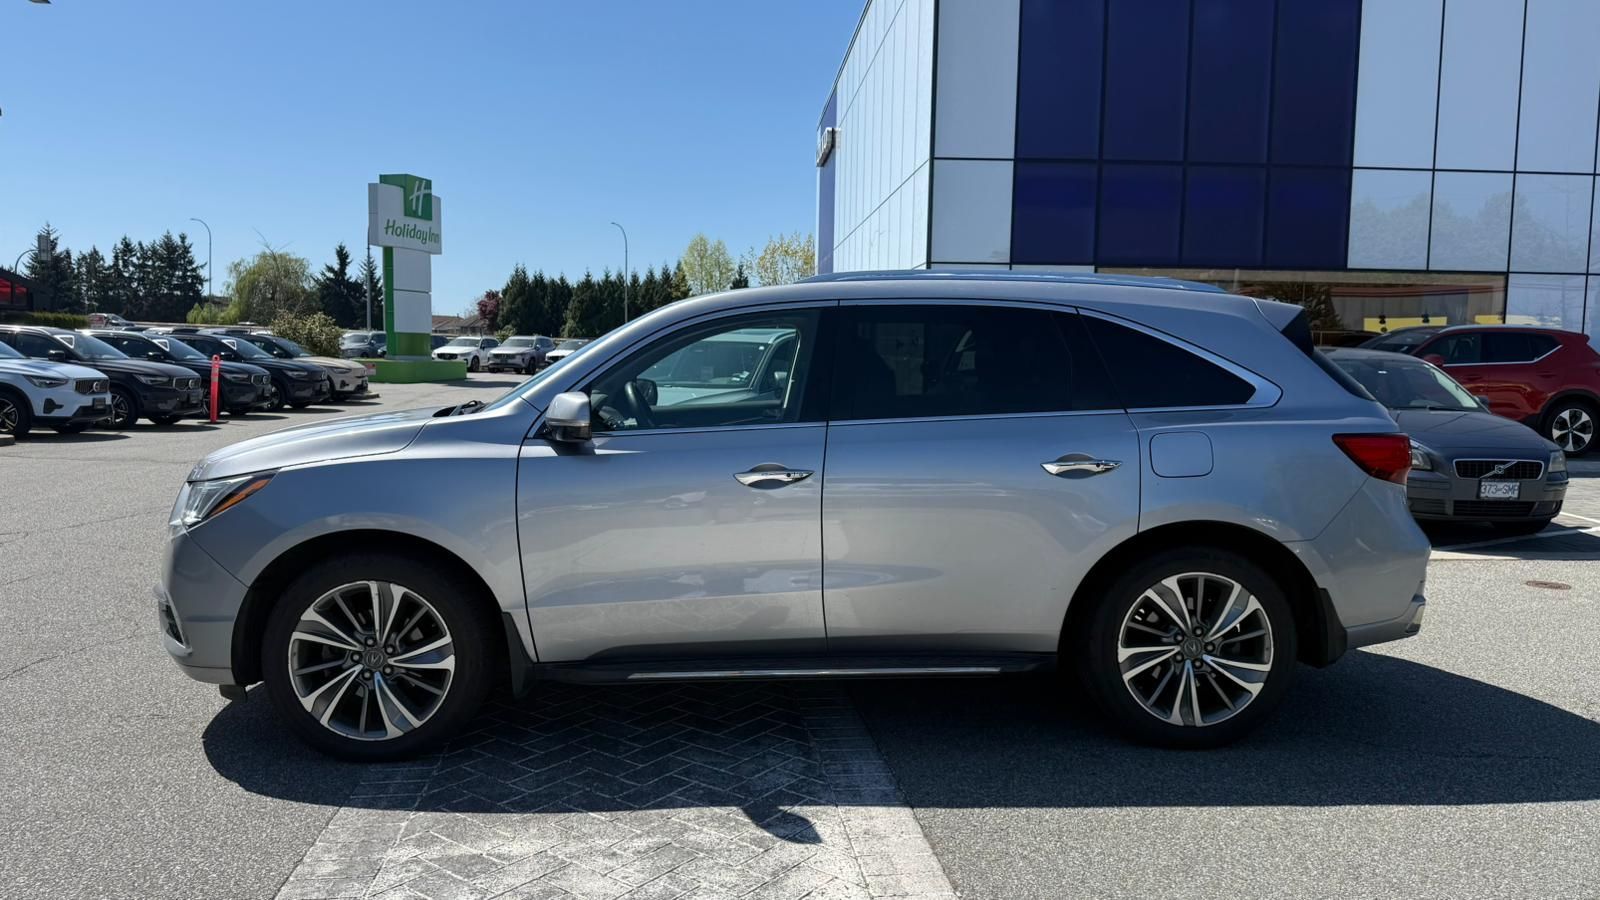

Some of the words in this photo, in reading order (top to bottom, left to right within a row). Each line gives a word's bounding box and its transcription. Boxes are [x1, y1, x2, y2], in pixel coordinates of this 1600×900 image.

[409, 180, 432, 216] H
[384, 218, 428, 244] Holiday
[428, 226, 440, 244] Inn
